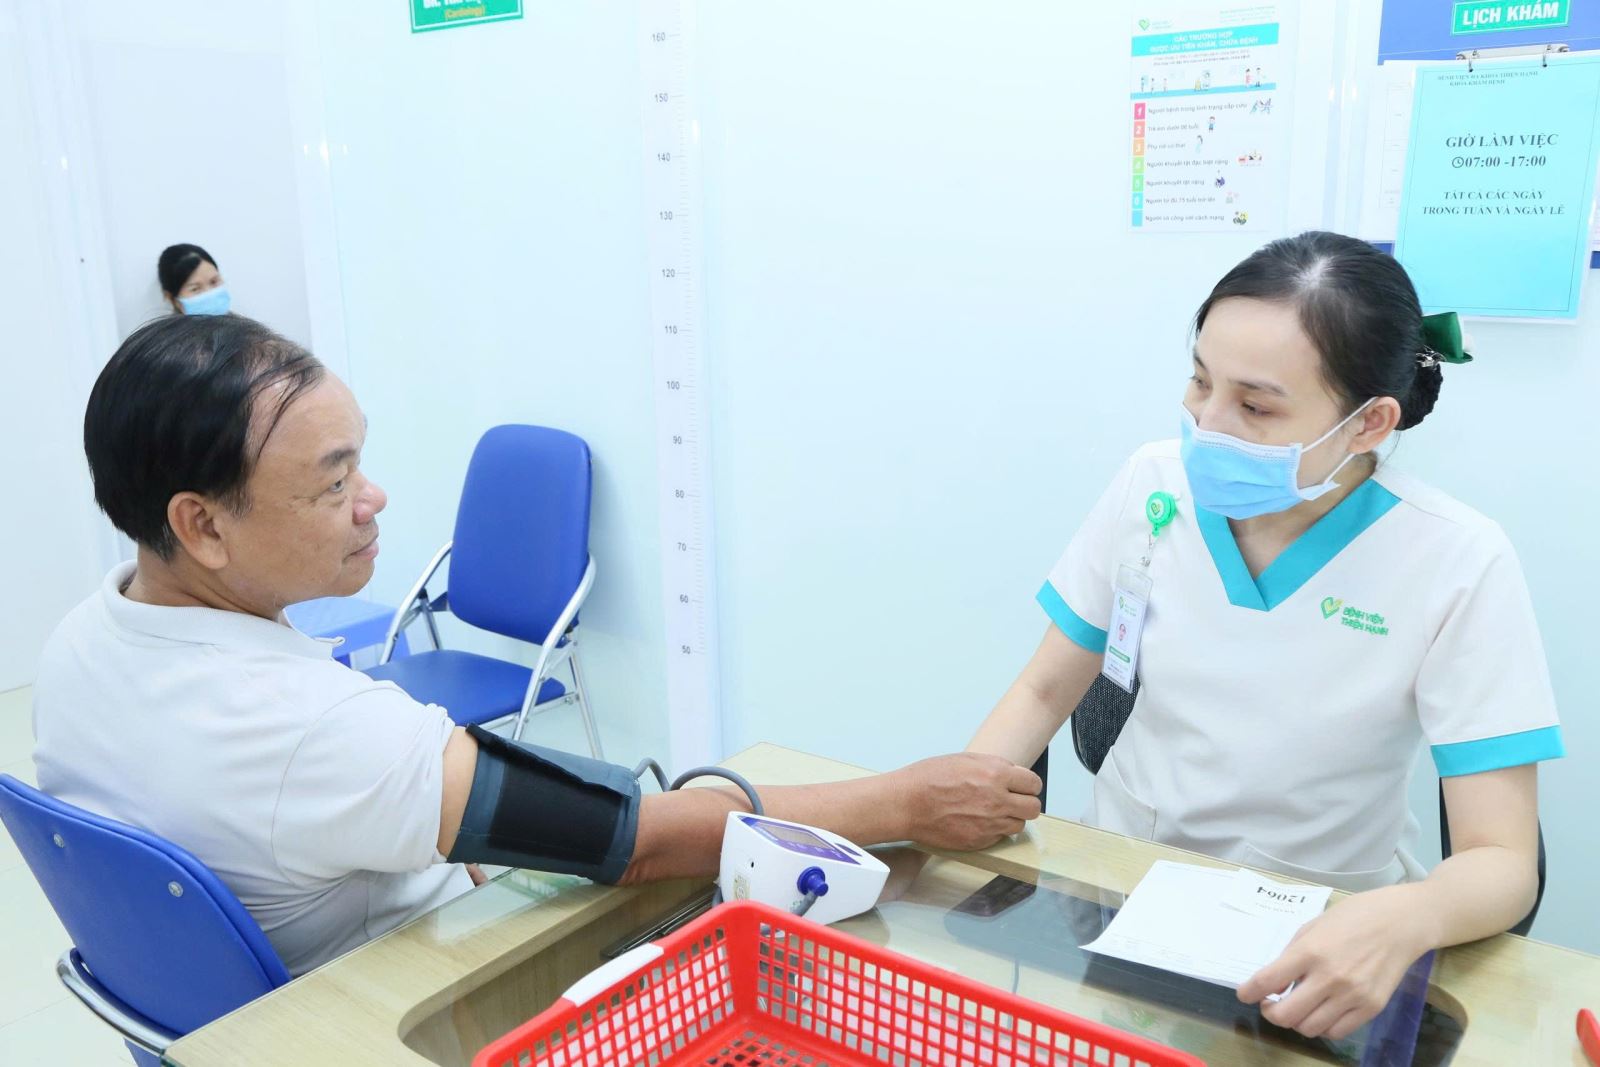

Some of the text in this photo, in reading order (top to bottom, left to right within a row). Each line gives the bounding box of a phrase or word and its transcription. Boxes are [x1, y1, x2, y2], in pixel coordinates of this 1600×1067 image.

[1462, 0, 1560, 28] LỊCH KHÁM
[652, 32, 666, 42] 160
[655, 93, 669, 103] 150
[1445, 131, 1560, 149] GIỜ LÀM VIỆC
[657, 152, 671, 162] 140
[1465, 156, 1500, 168] 07:00
[1486, 188, 1510, 200] CÁC
[1511, 188, 1545, 200] NGÀY
[1422, 206, 1460, 215] TRONG
[1494, 204, 1512, 215] VÀ
[1513, 204, 1548, 215] NGÀY
[659, 211, 673, 221] 130
[662, 268, 676, 278] 120
[665, 325, 678, 335] 110
[666, 380, 681, 390] 100
[672, 435, 682, 445] 90
[675, 489, 685, 499] 80
[677, 542, 687, 552] 70
[679, 594, 689, 603] 60
[681, 645, 691, 655] 50
[1256, 886, 1306, 904] 12064
